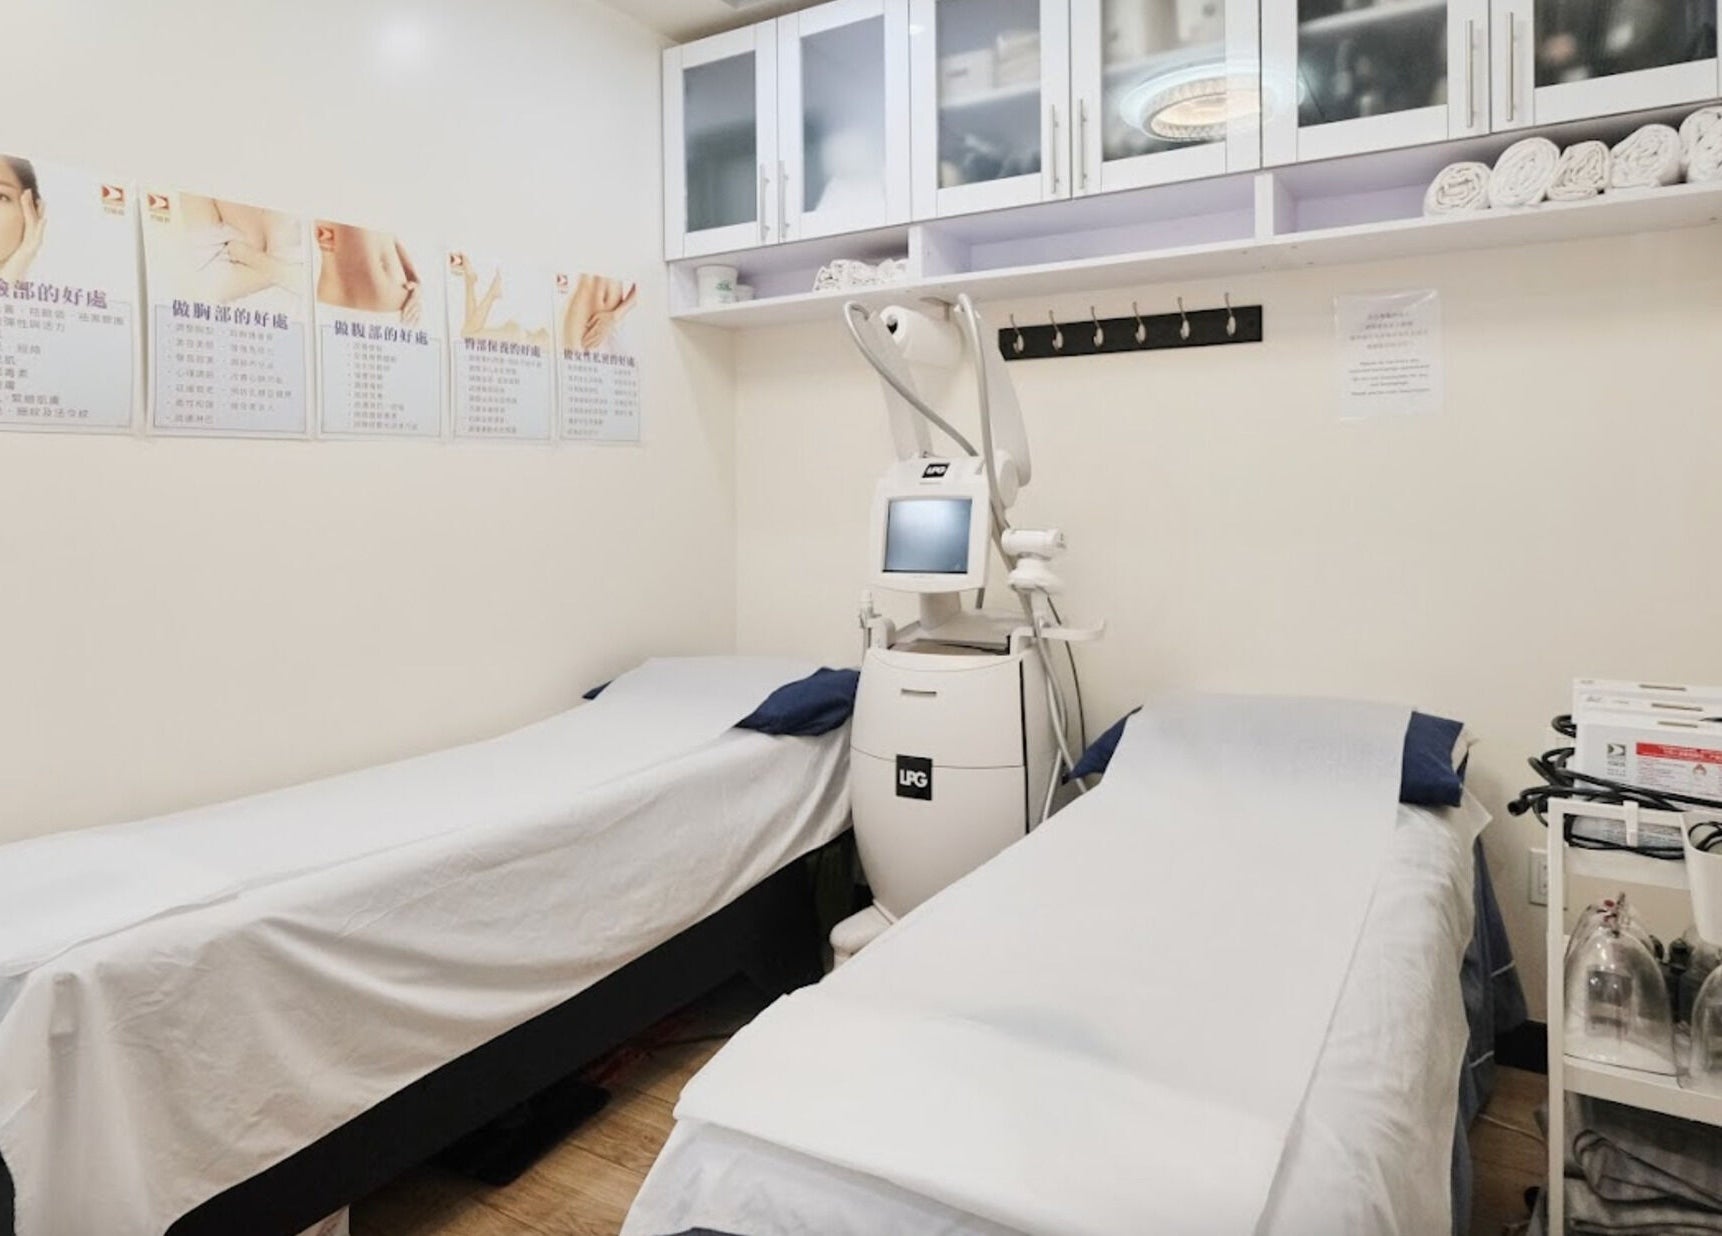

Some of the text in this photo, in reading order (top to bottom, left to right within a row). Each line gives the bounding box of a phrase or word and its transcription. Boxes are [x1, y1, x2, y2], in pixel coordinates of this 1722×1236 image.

[172, 299, 289, 330] 做胸部的好處
[335, 319, 429, 345] 做腹部的好處
[926, 466, 948, 475] LPG
[899, 769, 929, 788] LPG
